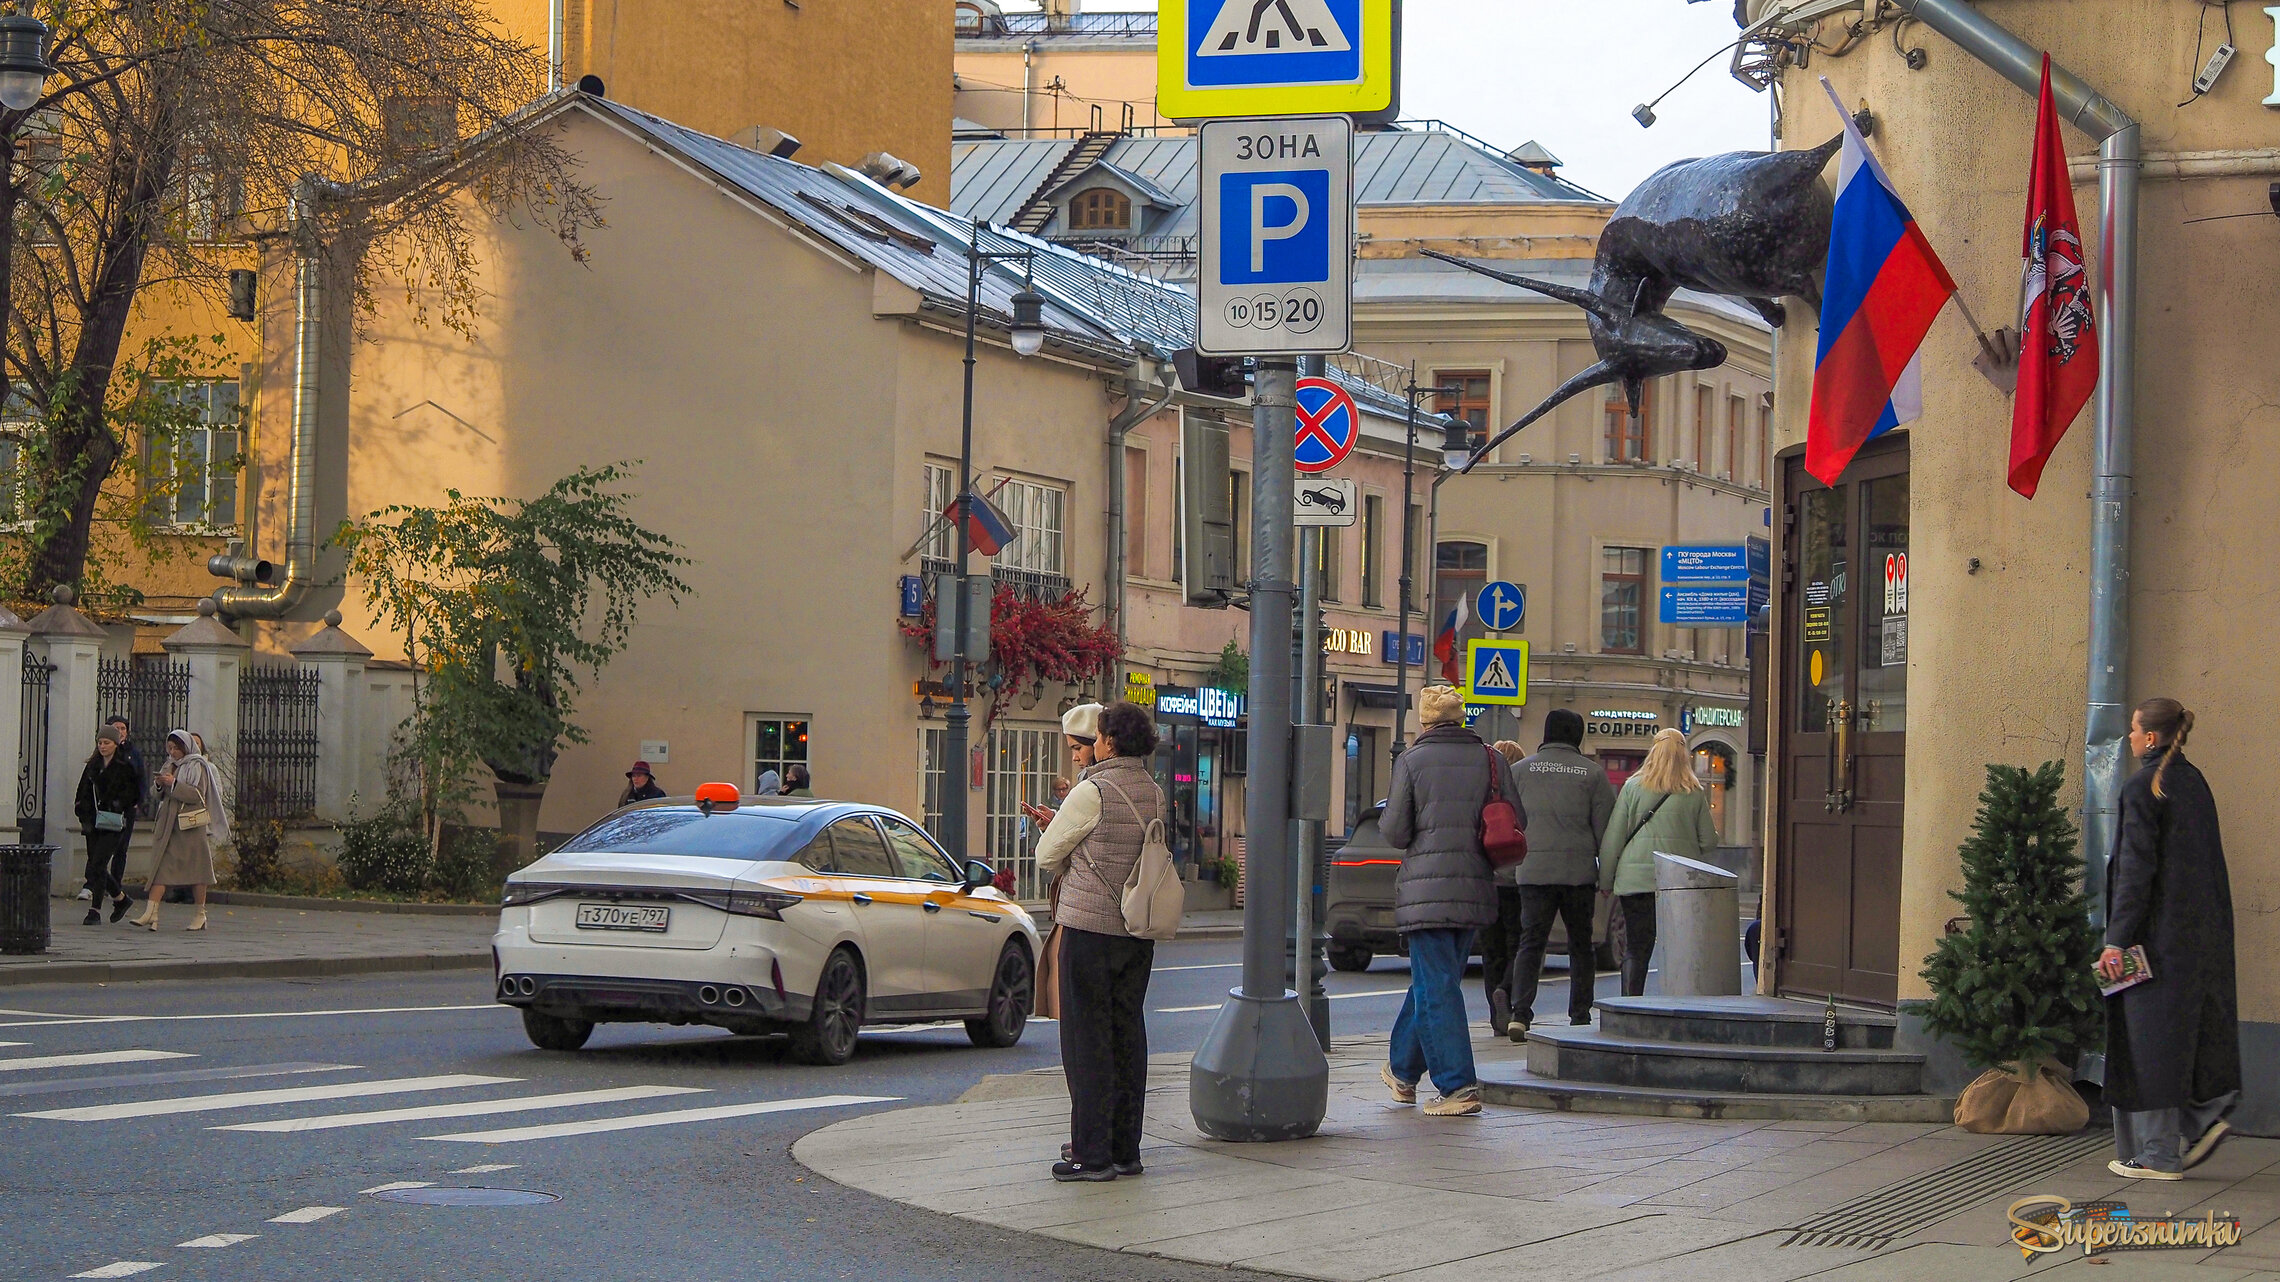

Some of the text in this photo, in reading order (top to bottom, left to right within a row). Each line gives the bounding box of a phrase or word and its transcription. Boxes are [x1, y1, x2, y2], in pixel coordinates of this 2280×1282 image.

[1236, 134, 1321, 160] ЗОНА
[1251, 183, 1310, 272] P
[1231, 298, 1318, 323] 10 15 20
[911, 583, 917, 603] 5
[1349, 630, 1372, 655] BAR
[1417, 641, 1422, 660] 7
[1160, 687, 1237, 721] КОФЕЙНЯ ЦВЕТЫ
[1685, 714, 1690, 731] 9
[1694, 706, 1742, 727] КОНДИТЕРСКАЯ
[1529, 766, 1588, 776] expedition
[583, 907, 664, 924] Т370УЕ 797
